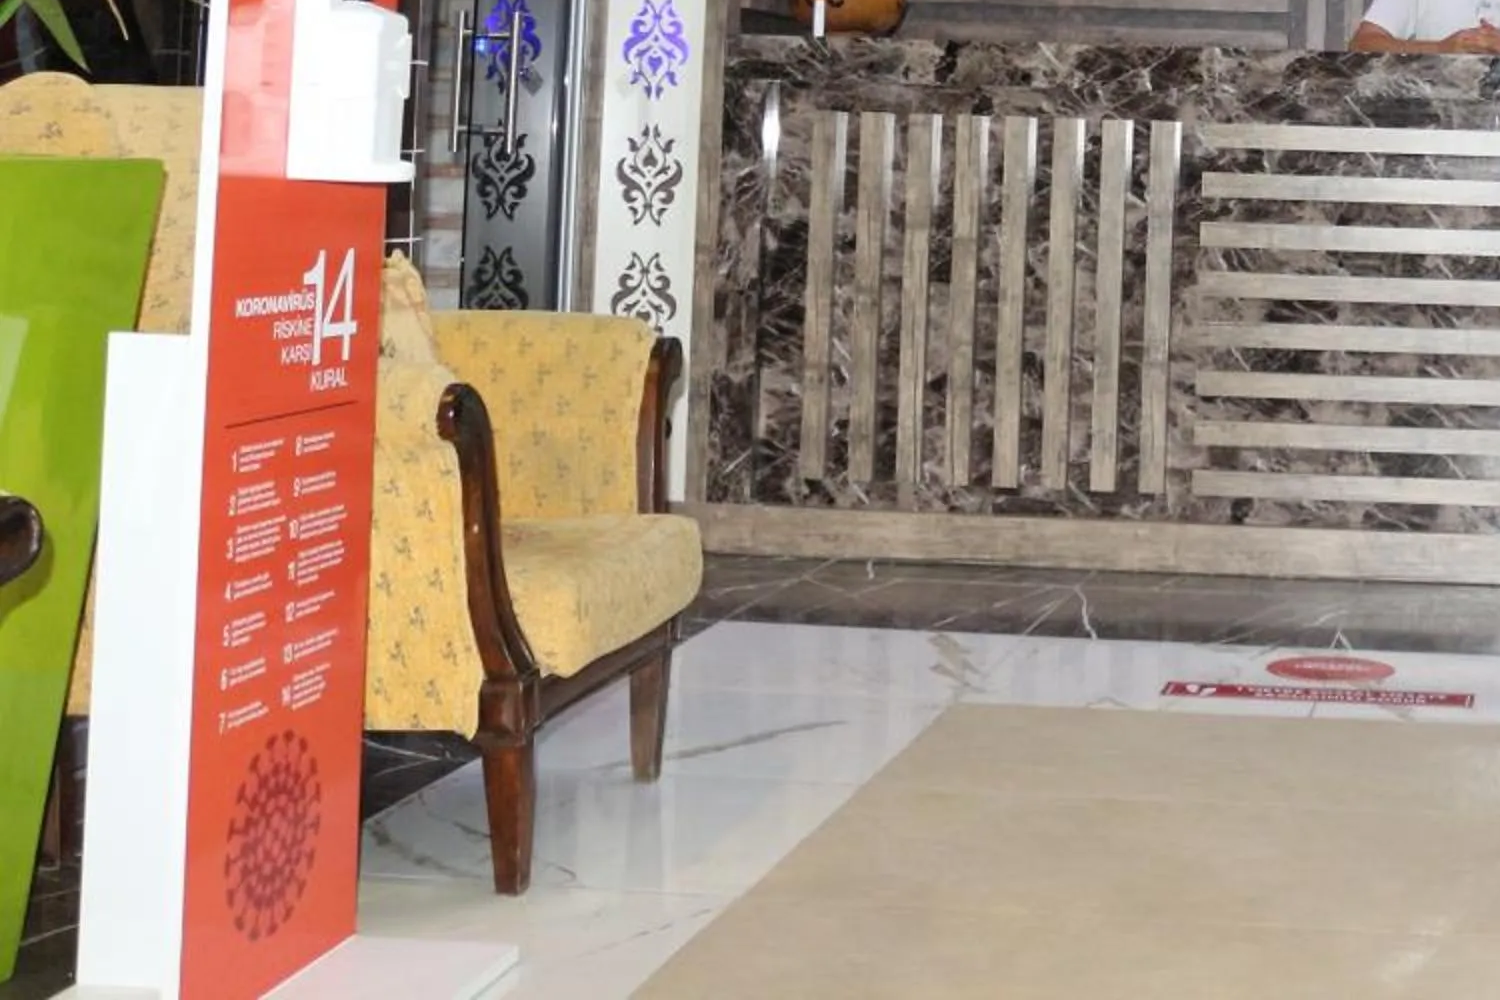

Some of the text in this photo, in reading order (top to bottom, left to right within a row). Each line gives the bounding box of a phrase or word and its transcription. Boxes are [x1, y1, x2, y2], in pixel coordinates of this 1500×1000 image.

[236, 289, 315, 318] KORONAVİRÜS
[303, 247, 358, 366] 14
[273, 315, 314, 340] RİSKİNE
[310, 367, 348, 392] KURAL
[232, 451, 238, 472] 1
[224, 582, 232, 601] 4
[218, 712, 226, 735] 7
